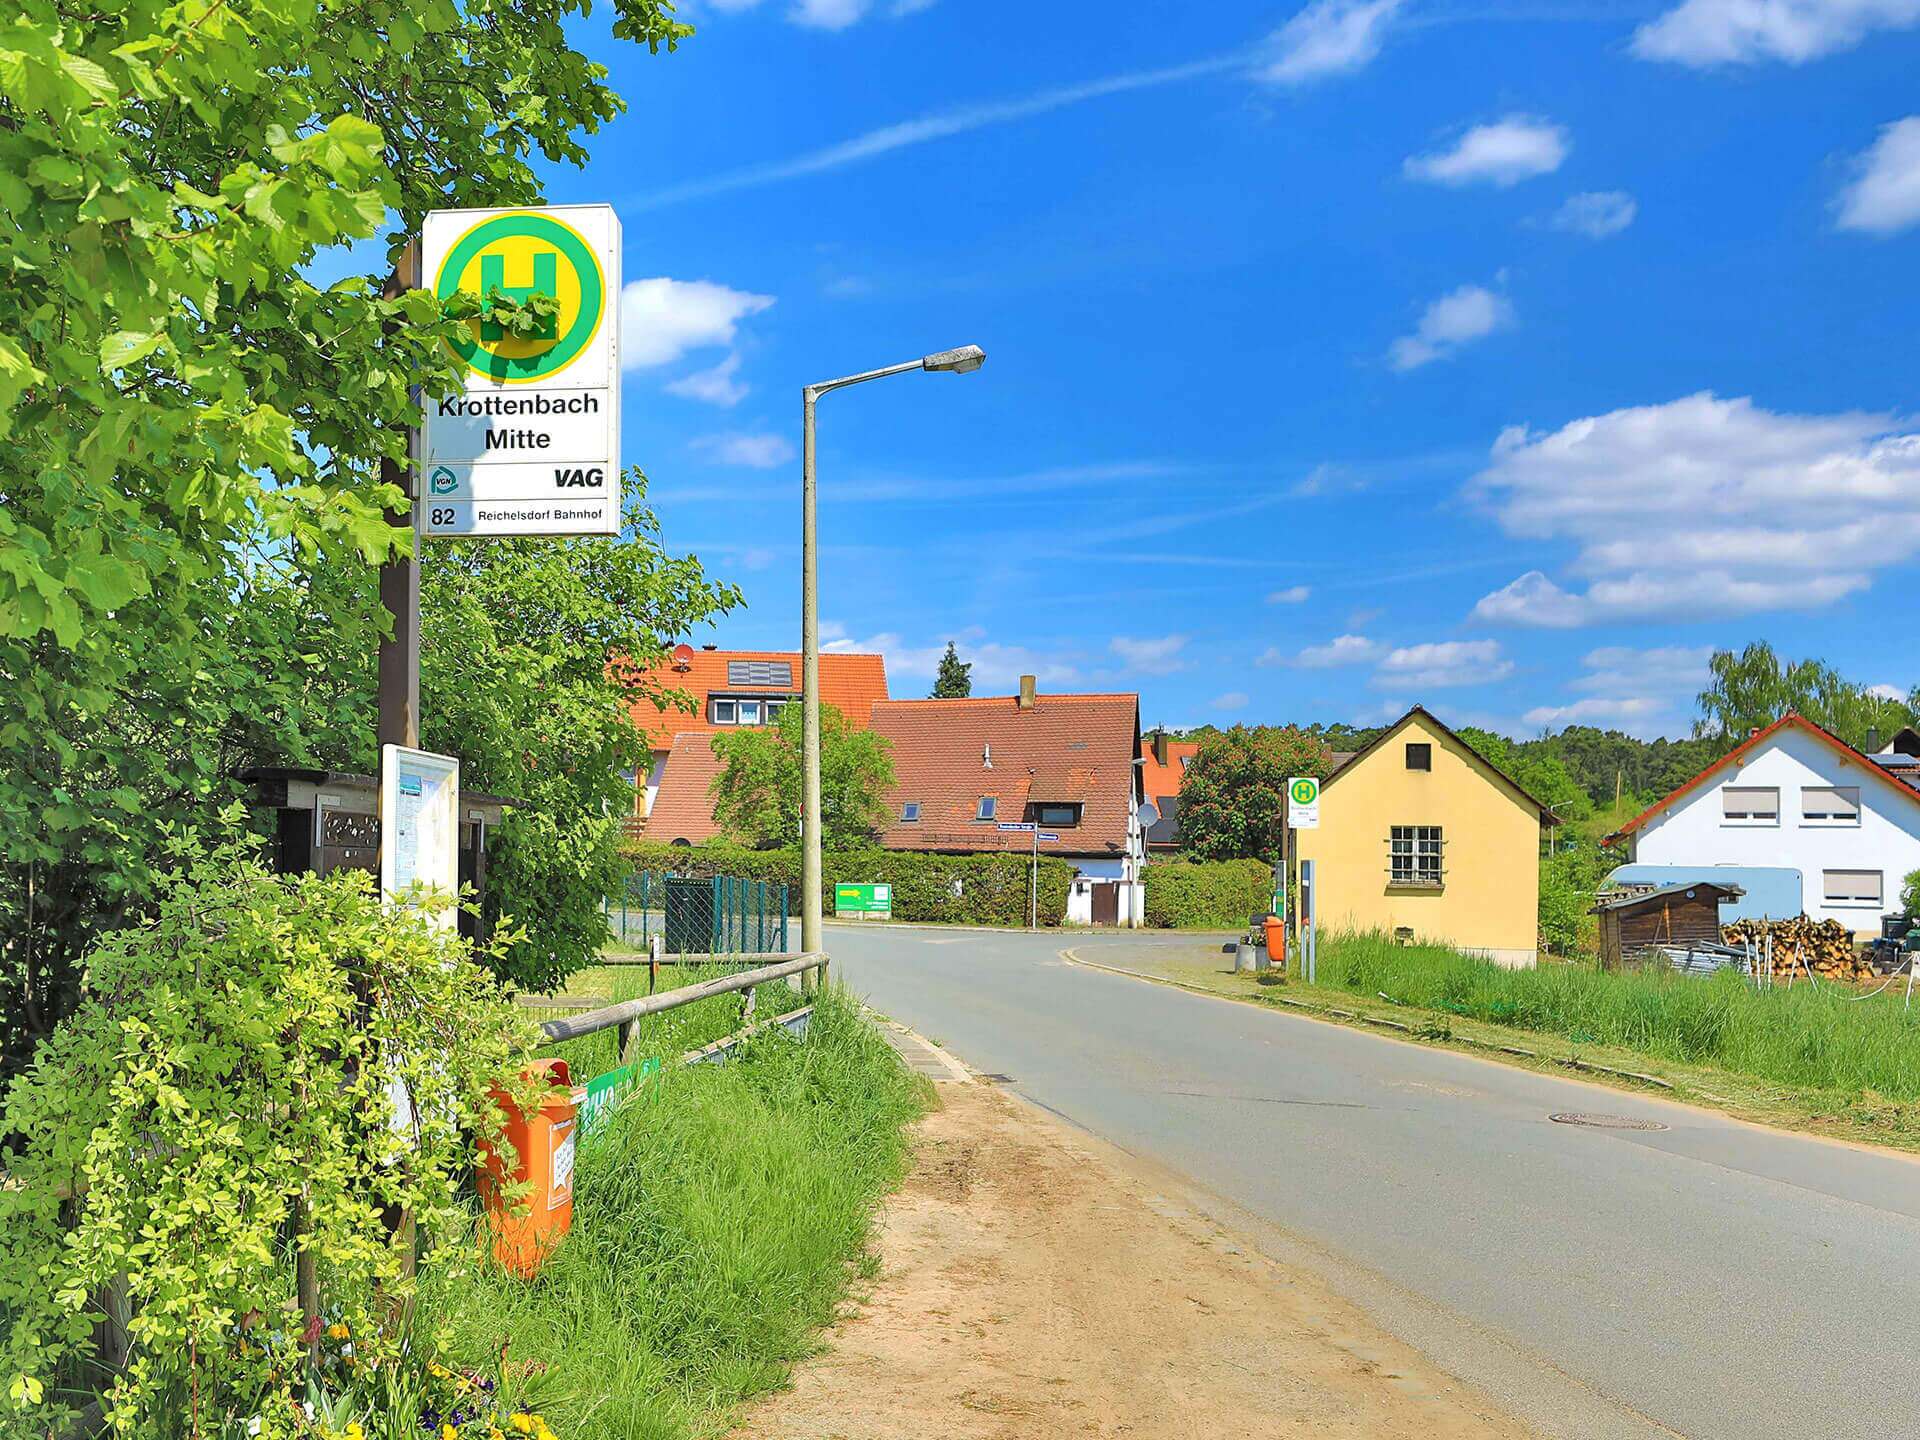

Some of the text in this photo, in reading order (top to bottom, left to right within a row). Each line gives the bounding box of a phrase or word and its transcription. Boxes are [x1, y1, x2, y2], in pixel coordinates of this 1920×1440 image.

[481, 253, 556, 341] H
[438, 394, 598, 416] Krottenbach
[485, 429, 551, 450] Mitte
[436, 477, 452, 486] VGN
[554, 468, 604, 488] VAG
[431, 508, 602, 525] 82 Reichelsdorf Bahnhof
[1298, 785, 1310, 798] H
